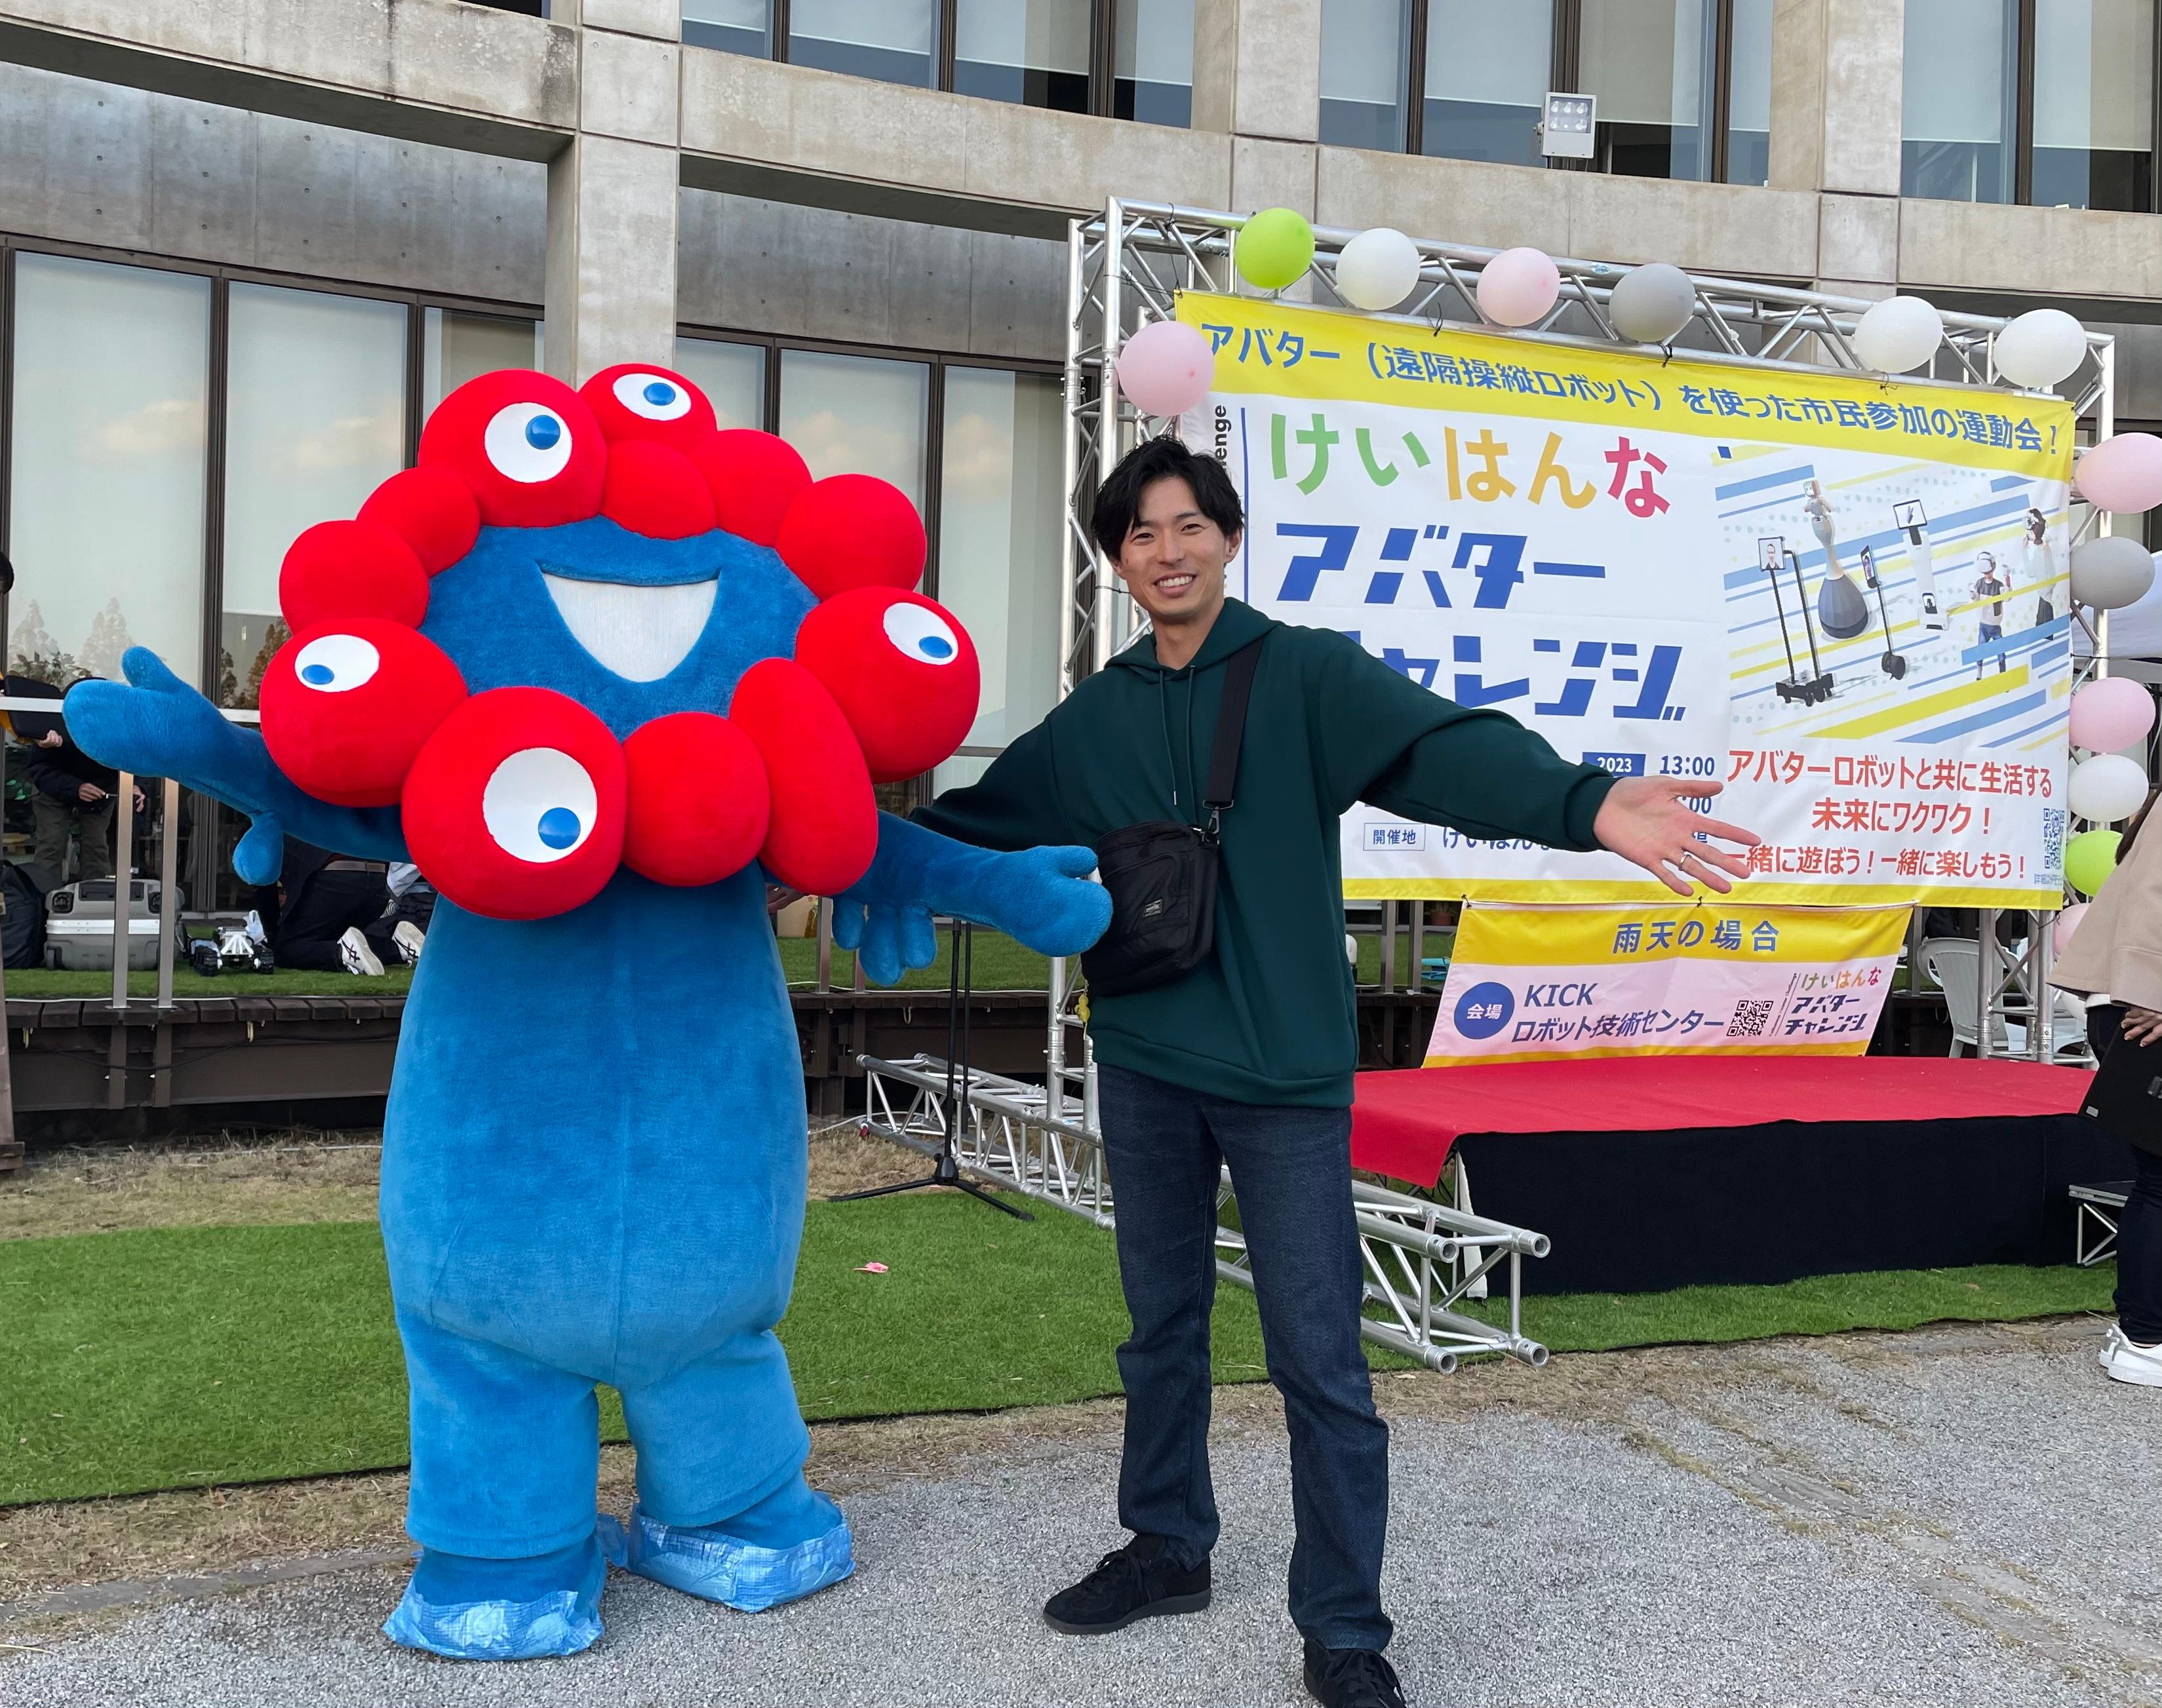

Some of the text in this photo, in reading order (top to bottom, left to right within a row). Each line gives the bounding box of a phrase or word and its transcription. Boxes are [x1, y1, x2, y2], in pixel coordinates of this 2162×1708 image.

[1271, 413, 1671, 518] けいはんな
[1276, 523, 1605, 609] アバター
[1597, 757, 1632, 773] 2023
[1659, 756, 1715, 776] 13:00
[1727, 748, 2052, 798] アバターロボットと共に生活する
[1813, 796, 1990, 835] 未来にワクワク！
[1373, 829, 1416, 845] 開催地
[1613, 920, 1779, 954] 雨天の場合
[1801, 966, 1882, 991] けいはんな
[1523, 983, 1598, 1007] KICK
[1791, 994, 1860, 1014] アバター
[1466, 1003, 1503, 1020] 会場
[1512, 1009, 1725, 1043] ロボット技術センター
[1784, 1013, 1868, 1036] チャレンジ
